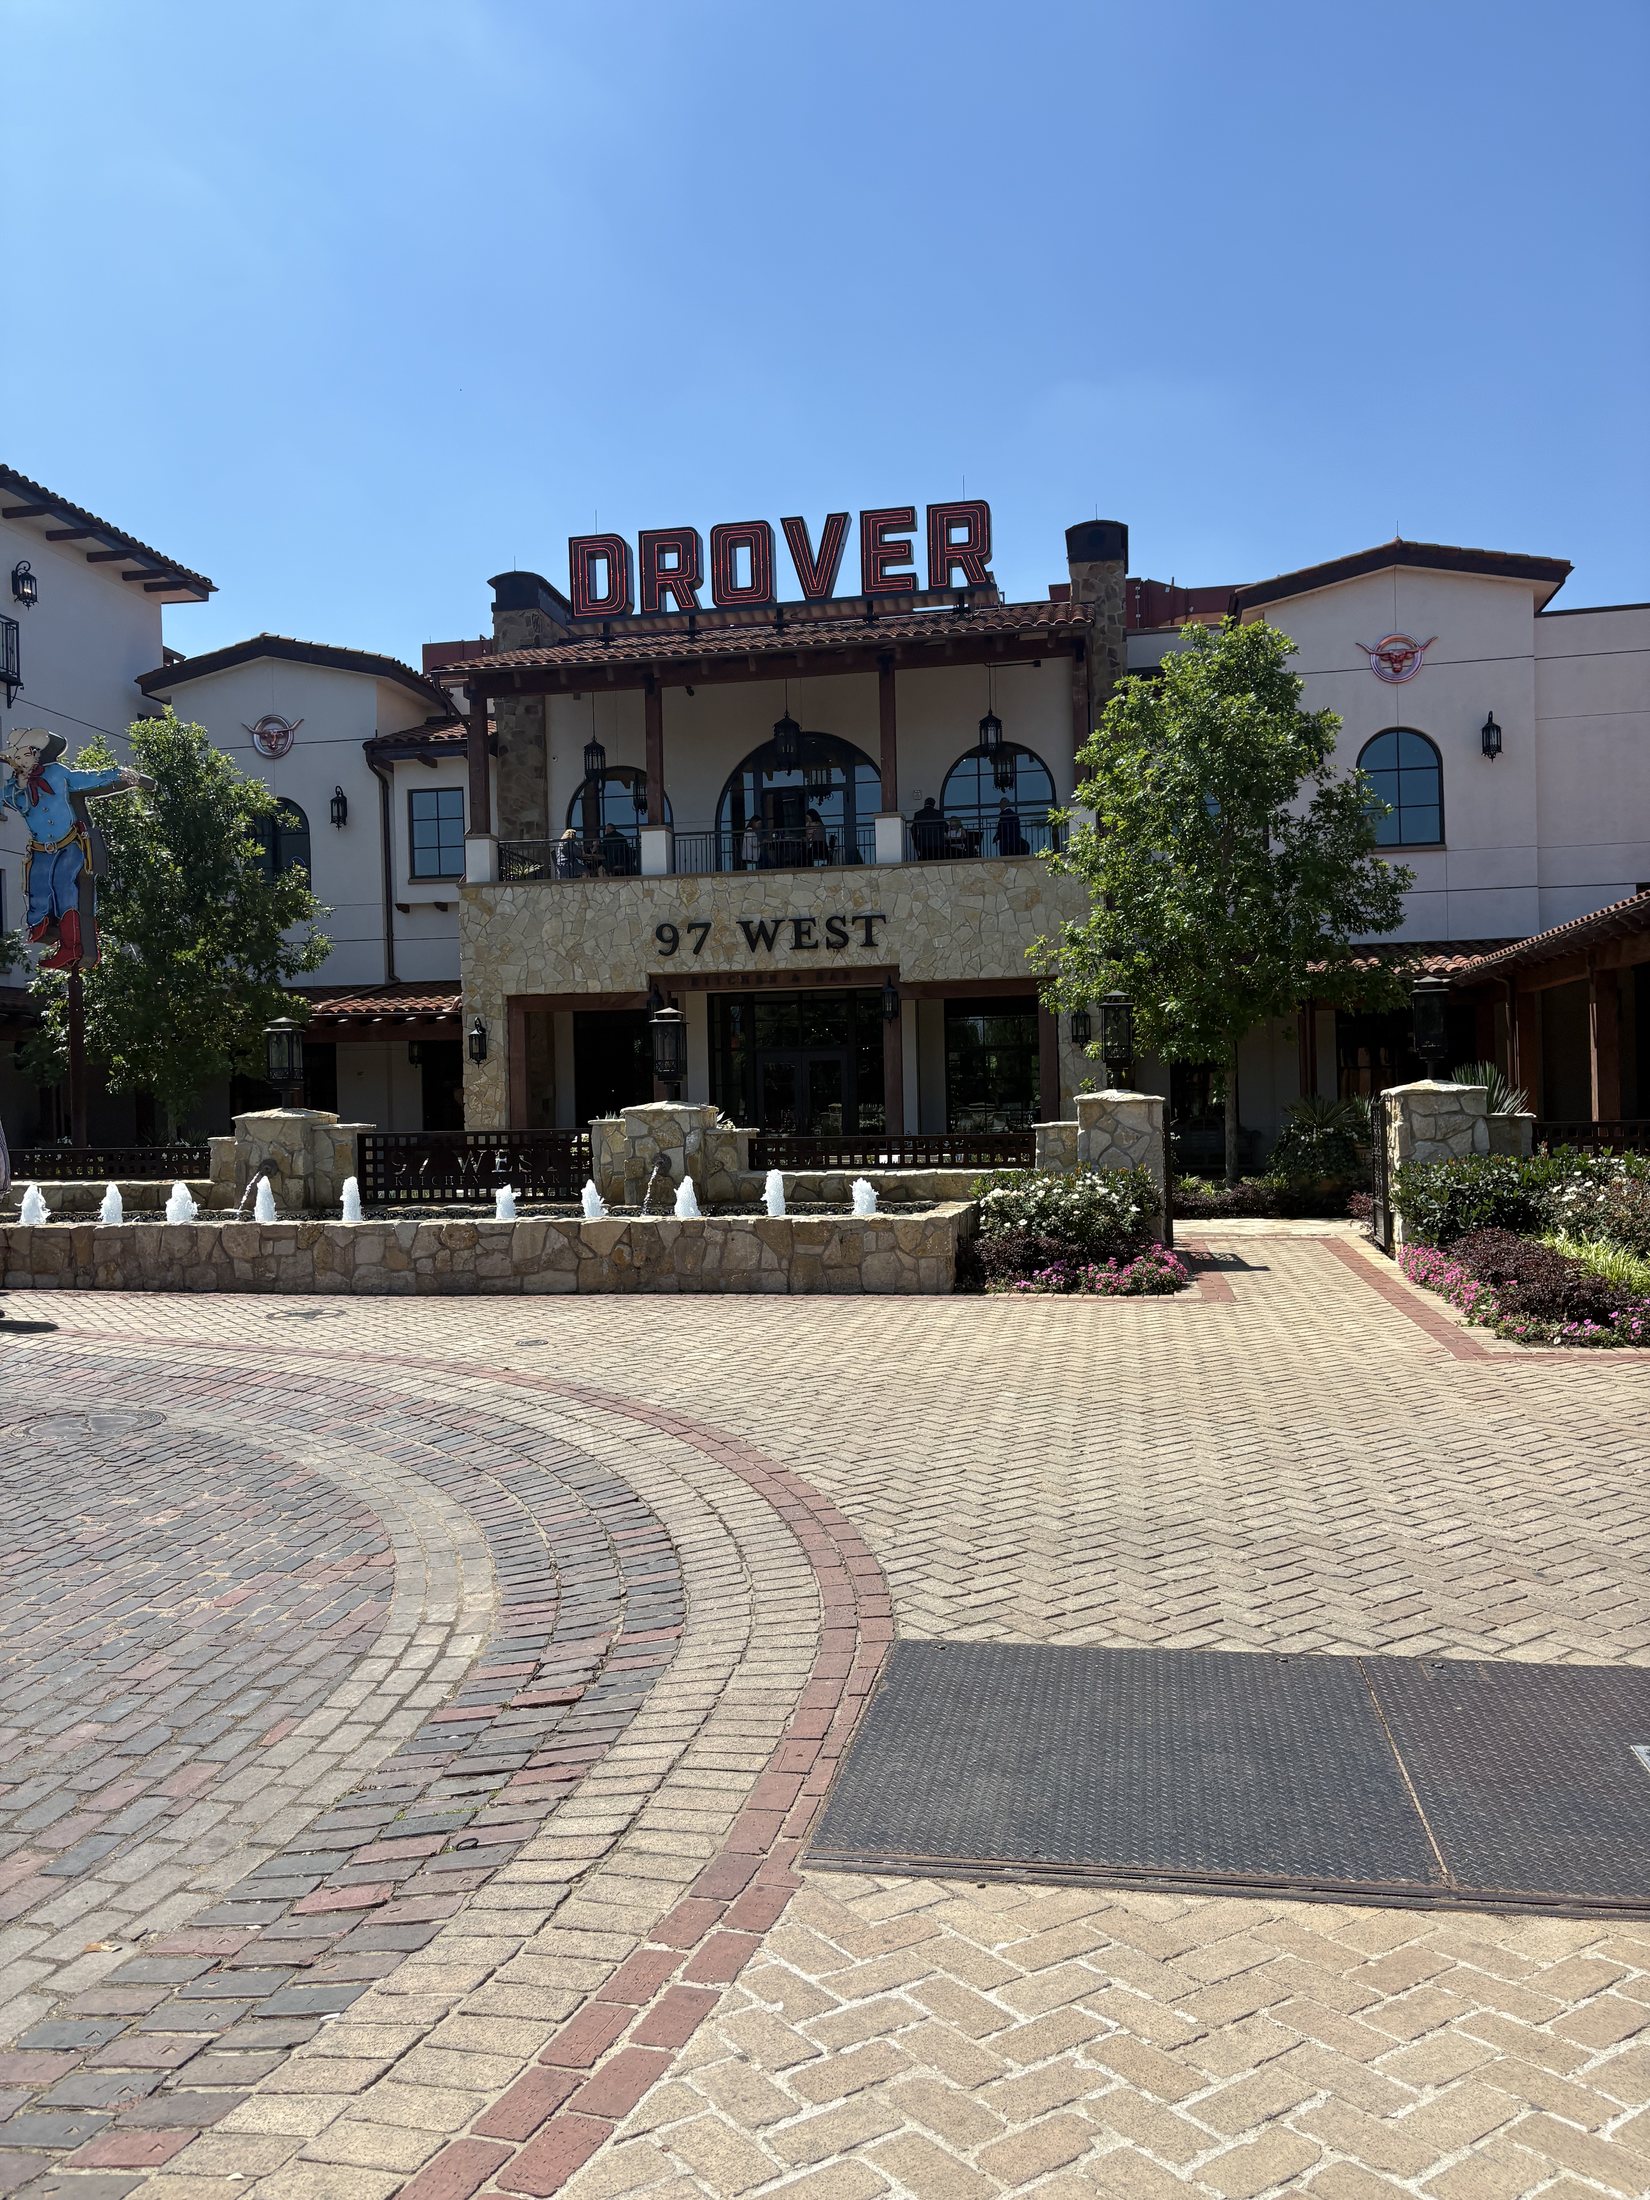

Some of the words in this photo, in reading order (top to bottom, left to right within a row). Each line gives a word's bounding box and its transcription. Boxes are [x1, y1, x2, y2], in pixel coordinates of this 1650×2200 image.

[568, 499, 993, 618] DROVER
[655, 922, 712, 957] 97
[736, 914, 887, 953] WEST
[450, 1148, 564, 1174] WEST
[394, 1175, 481, 1186] KITCHEN
